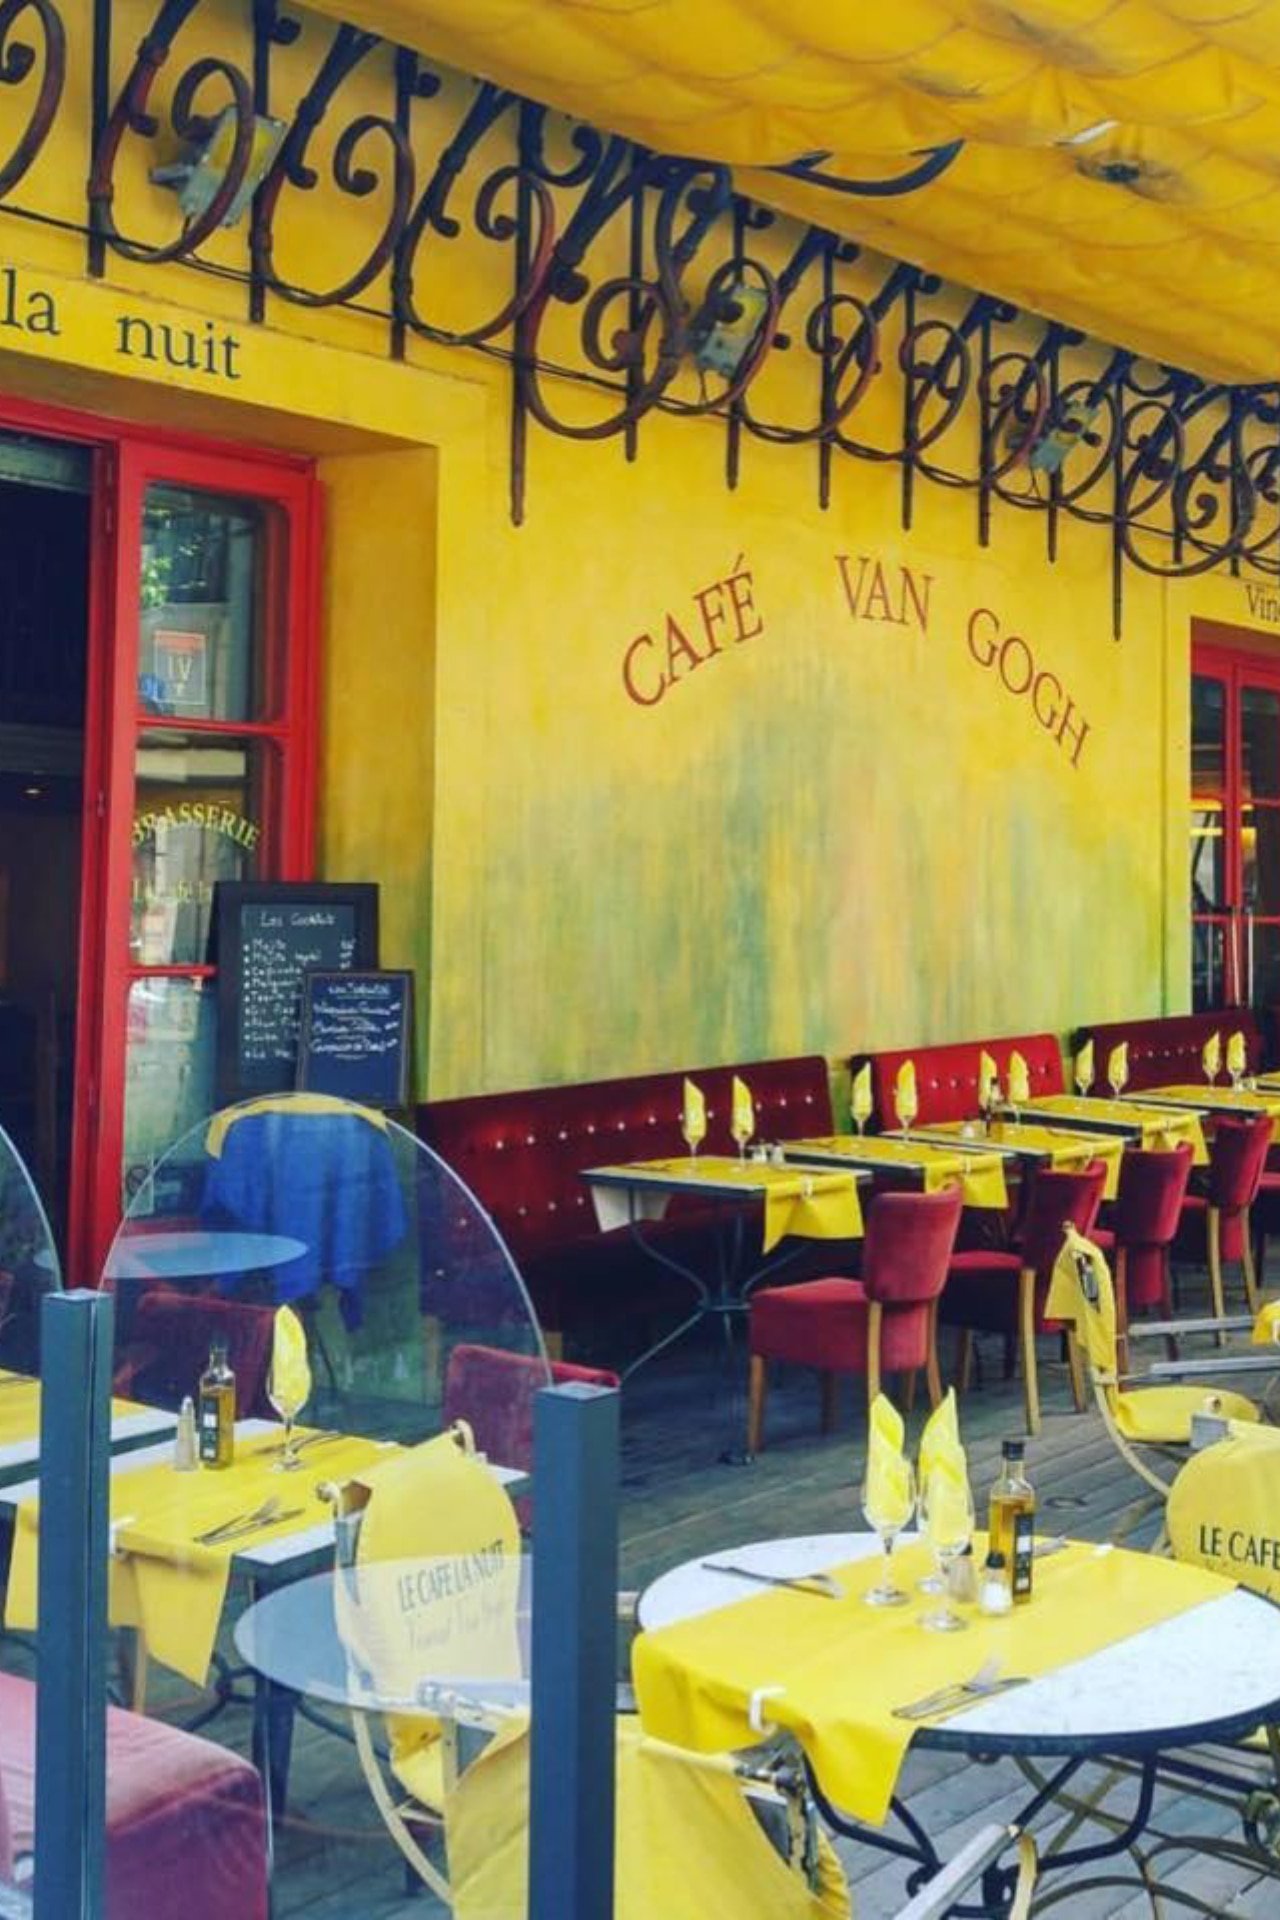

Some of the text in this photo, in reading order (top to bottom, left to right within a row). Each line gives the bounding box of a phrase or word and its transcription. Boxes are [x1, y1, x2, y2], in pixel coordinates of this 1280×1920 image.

[0, 267, 242, 379] la nuit
[1245, 583, 1280, 623] Vin
[622, 552, 1090, 769] CAFÉ VAN GOGH
[131, 802, 261, 850] BRASSERIE
[1200, 1524, 1280, 1570] LE CAFE
[398, 1575, 415, 1612] LE
